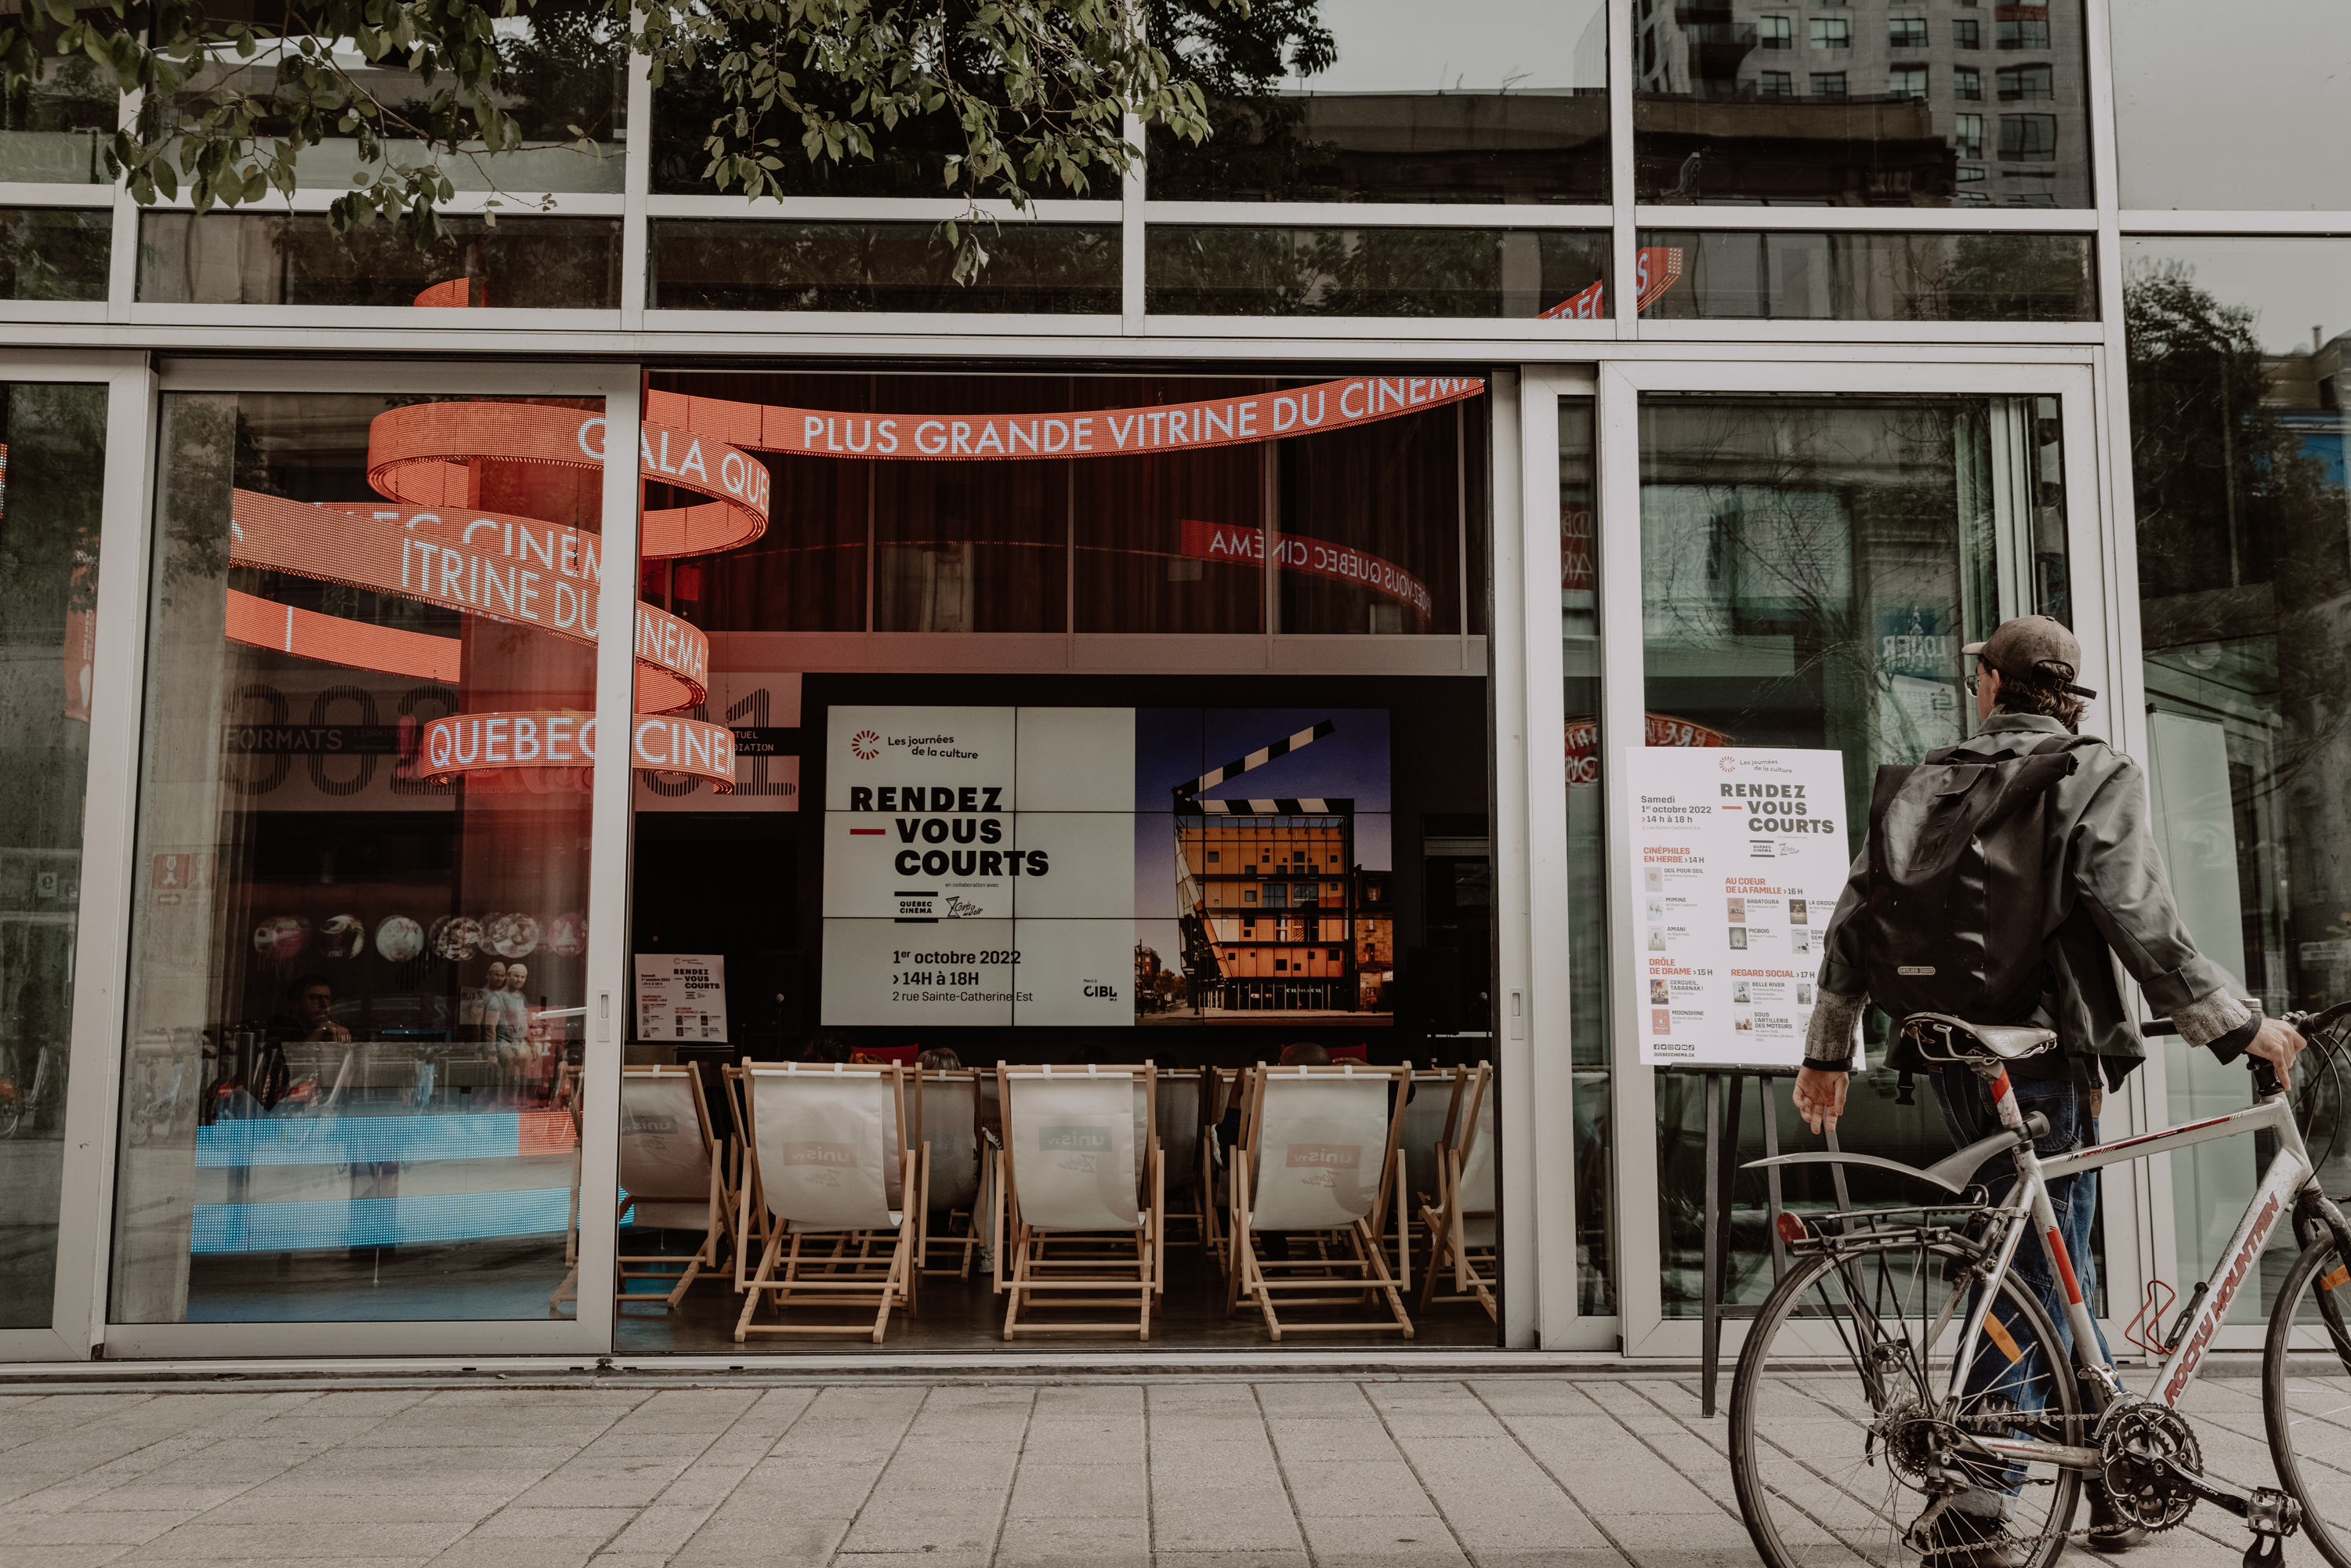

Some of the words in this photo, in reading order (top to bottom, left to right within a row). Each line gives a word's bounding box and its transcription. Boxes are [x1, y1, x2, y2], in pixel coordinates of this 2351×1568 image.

[804, 415, 899, 453] PLUS
[914, 418, 1092, 454] GRANDE
[1107, 401, 1257, 450] VITRINE
[1273, 390, 1324, 432] DU
[888, 737, 906, 746] Les
[907, 734, 955, 748] journées
[911, 746, 925, 755] de
[928, 747, 937, 756] la
[940, 748, 978, 759] culture
[1720, 784, 1806, 798] RENDEZ
[850, 787, 1003, 812] RENDEZ
[1747, 801, 1807, 816] VOUS
[895, 818, 1002, 845] VOUS
[1748, 818, 1834, 834] COURTS
[1643, 845, 1690, 854] CINÉPHILES
[894, 849, 1049, 877] COURTS
[893, 951, 911, 964] 1er
[915, 951, 976, 964] octobre
[980, 951, 1021, 964] 2022
[1649, 957, 1675, 965] DRÔLE
[903, 972, 932, 986] 14H
[936, 971, 945, 986] à
[950, 972, 979, 986] 18H
[893, 992, 900, 1001] 2
[922, 992, 1012, 1001] Sainte-Catherine
[1016, 992, 1033, 1001] Est
[1083, 986, 1118, 997] CIBL
[2164, 1313, 2213, 1409] ROCKY
[2212, 1191, 2280, 1322] MOUNTAIN
